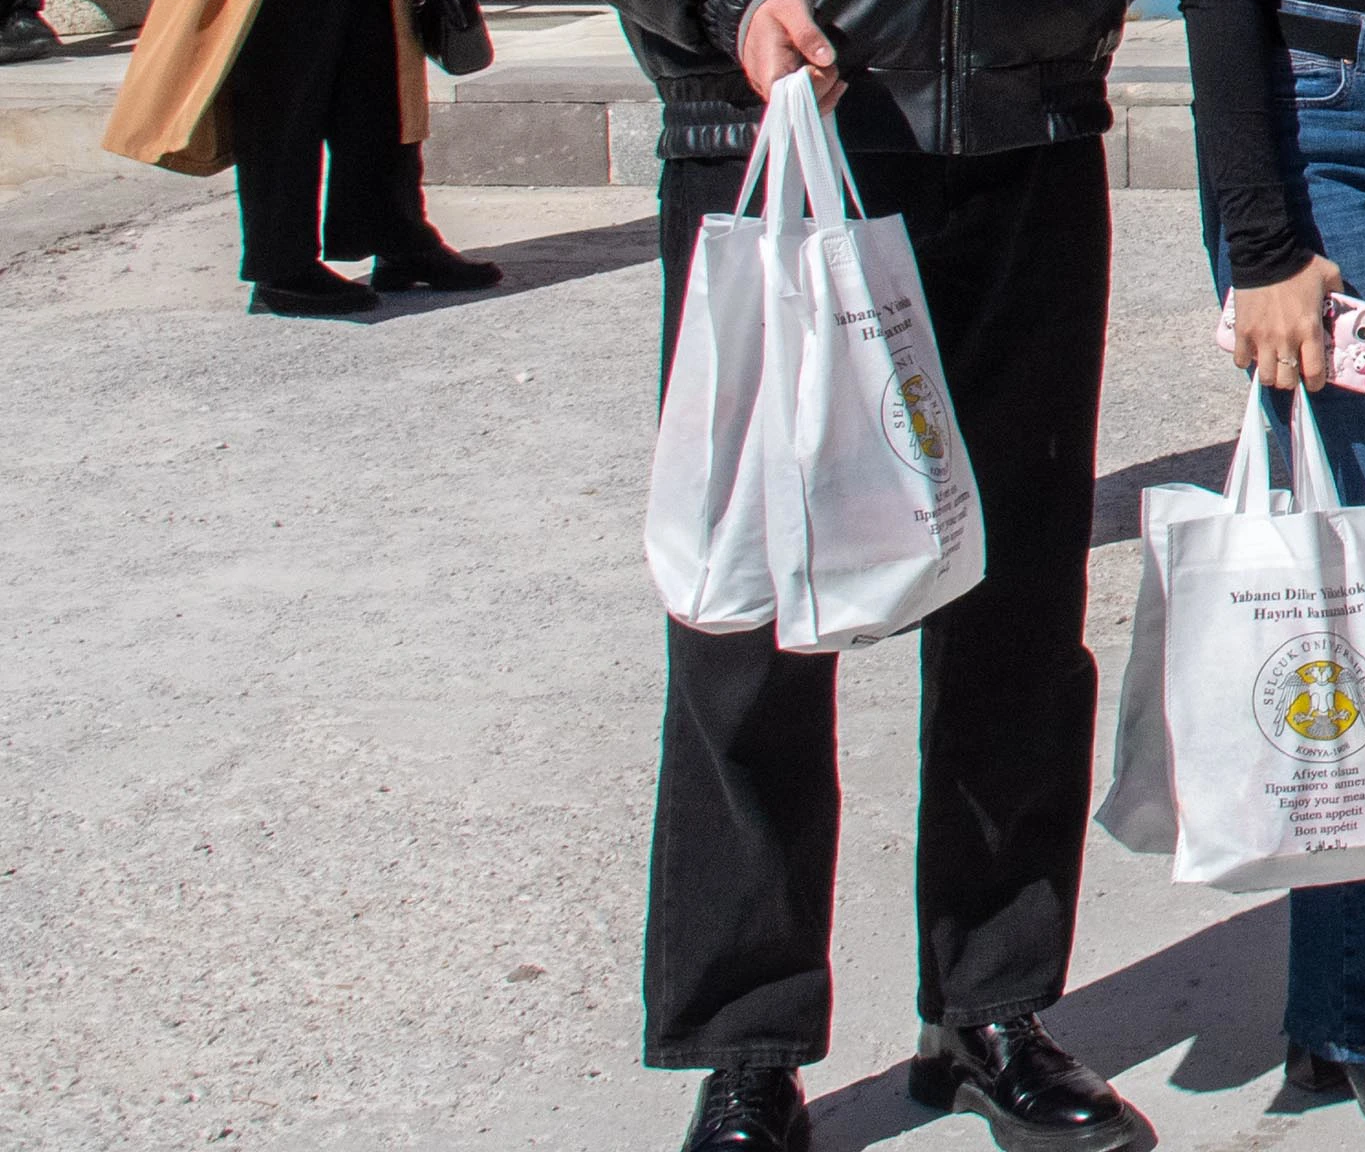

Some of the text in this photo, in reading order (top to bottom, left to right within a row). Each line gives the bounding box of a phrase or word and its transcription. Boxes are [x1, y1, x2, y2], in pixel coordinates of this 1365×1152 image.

[1230, 591, 1281, 605] Yabancı
[1254, 607, 1302, 622] Hayırlı
[1293, 766, 1359, 781] Afiyet olsun
[1280, 797, 1311, 809] Enjoy
[1314, 796, 1340, 808] your
[1290, 806, 1363, 823] Guten appetit
[1295, 826, 1317, 836] Bon
